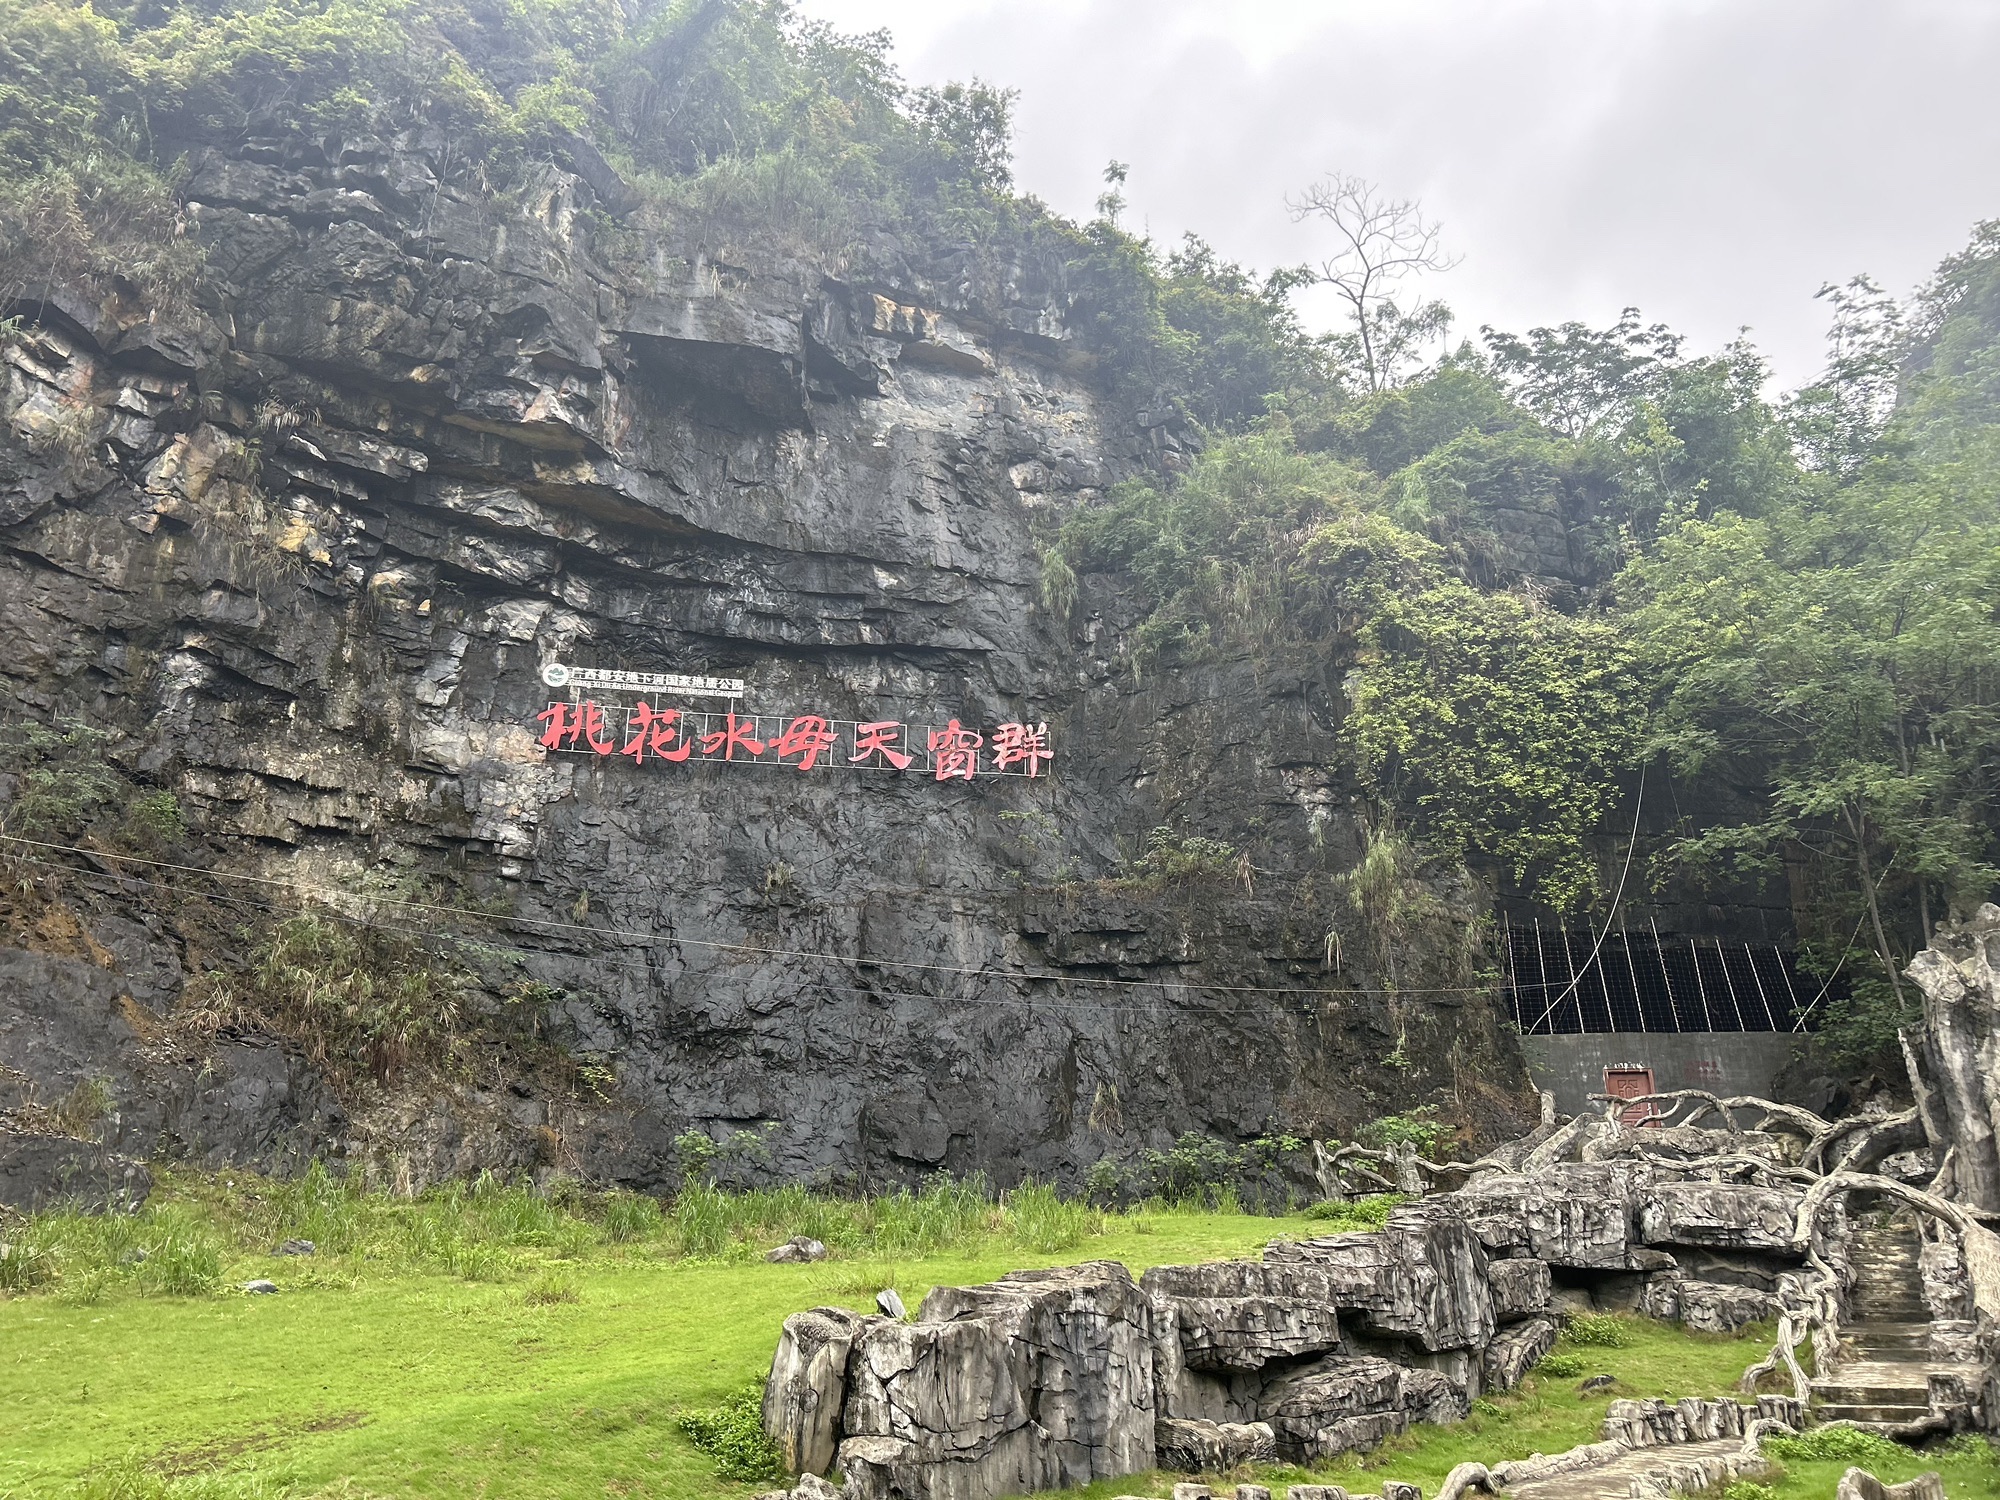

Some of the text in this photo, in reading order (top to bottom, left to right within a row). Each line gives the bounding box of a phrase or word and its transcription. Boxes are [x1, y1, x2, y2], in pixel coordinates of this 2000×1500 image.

[569, 667, 744, 690] 广西都安地下河国家地质公园
[537, 701, 1053, 781] 桃花水母天窗群
